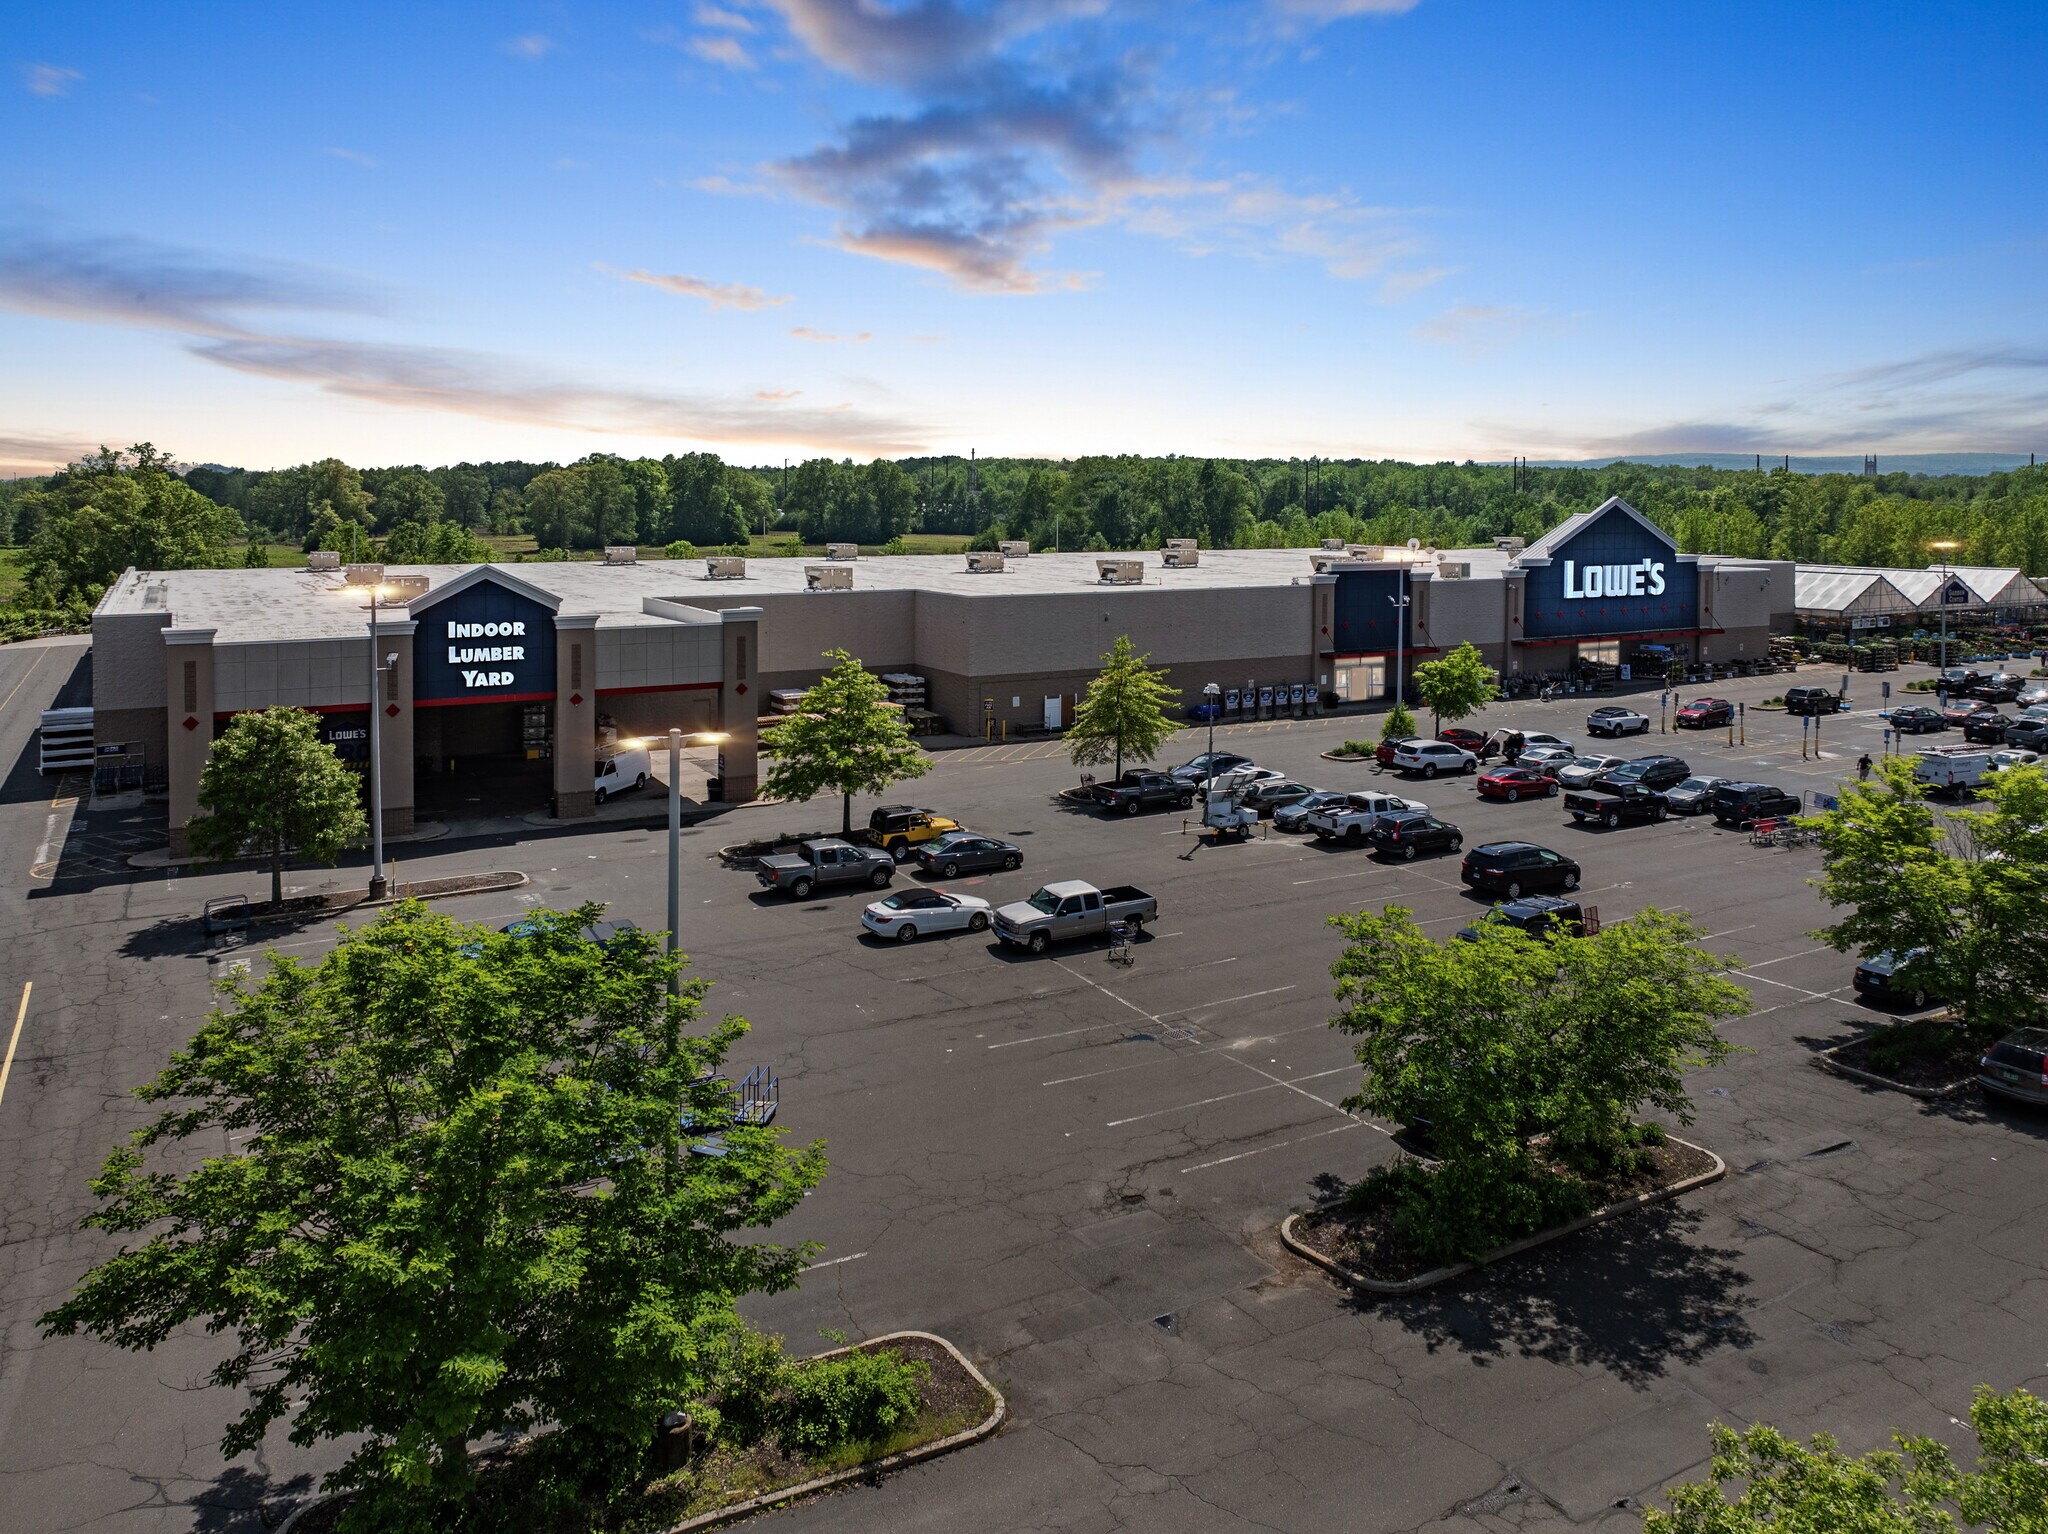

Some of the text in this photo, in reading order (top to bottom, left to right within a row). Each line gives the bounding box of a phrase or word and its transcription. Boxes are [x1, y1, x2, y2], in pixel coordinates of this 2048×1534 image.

[1563, 558, 1665, 599] LOWE'S
[447, 621, 526, 638] INDOOR
[448, 645, 525, 664] LUMBER
[461, 670, 515, 687] YARD
[328, 729, 367, 740] LOWE'S
